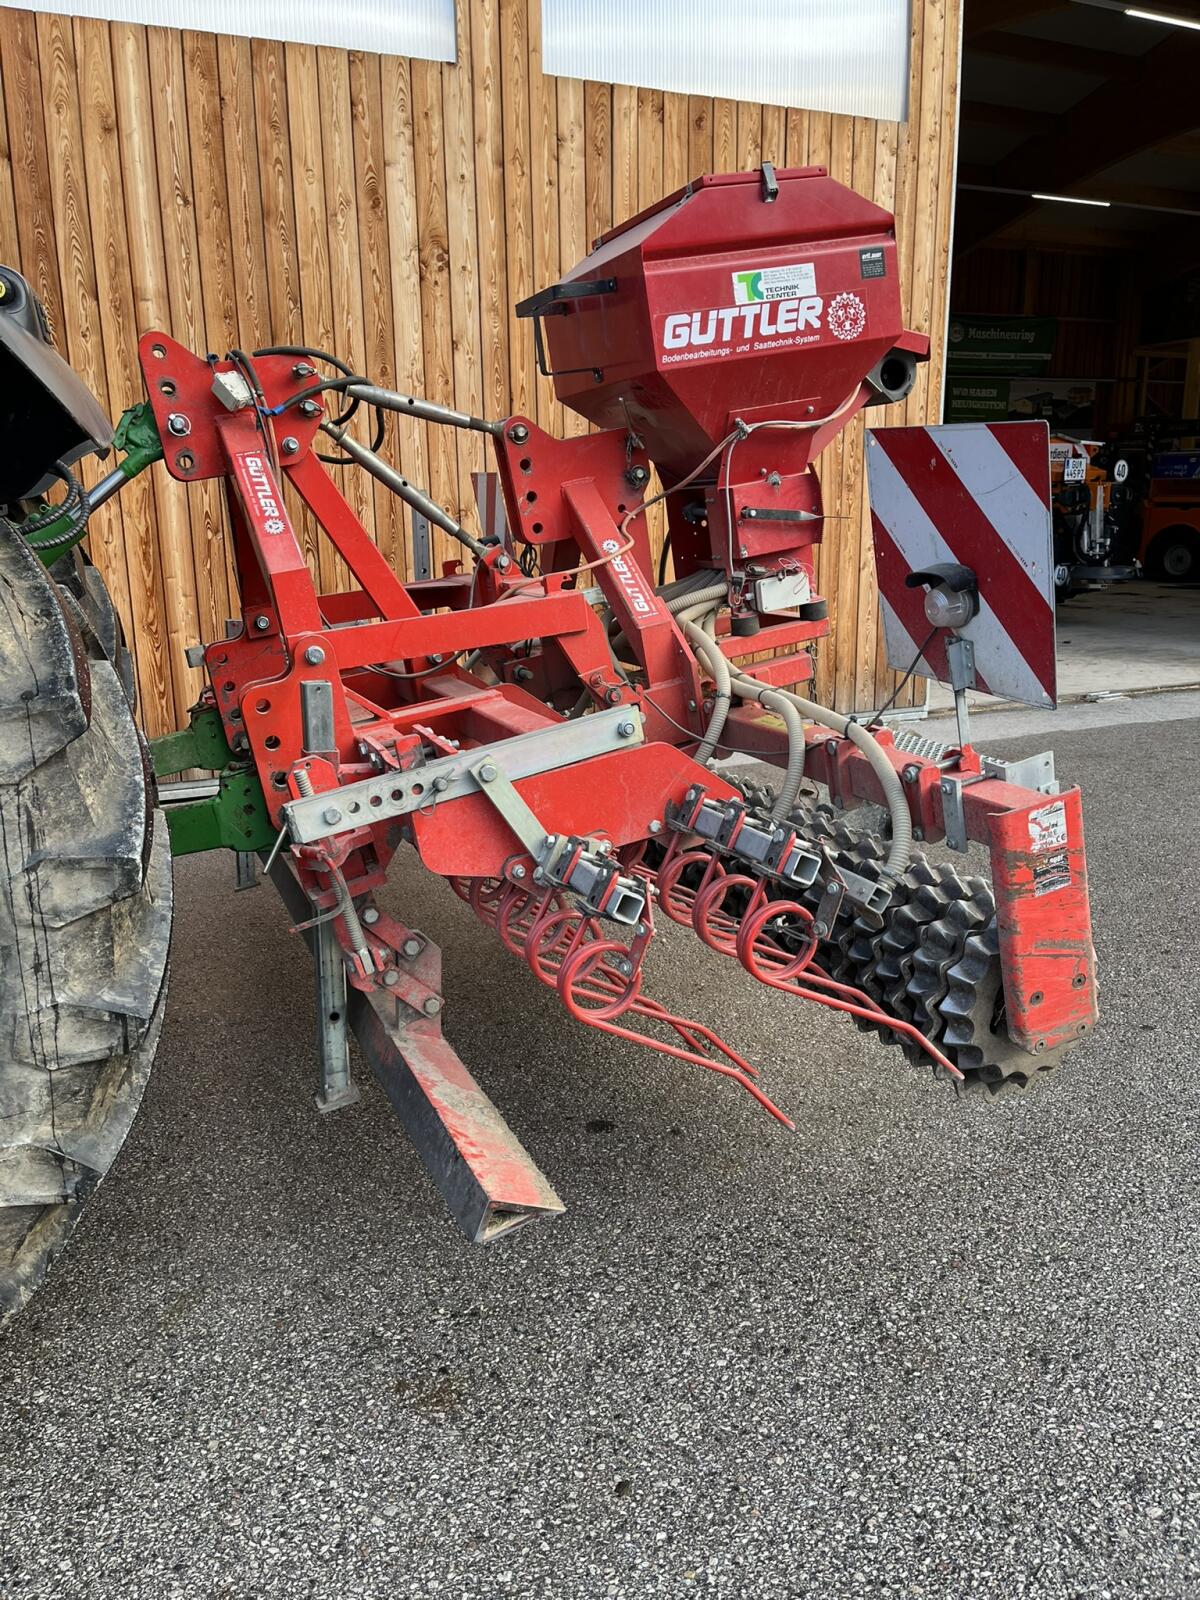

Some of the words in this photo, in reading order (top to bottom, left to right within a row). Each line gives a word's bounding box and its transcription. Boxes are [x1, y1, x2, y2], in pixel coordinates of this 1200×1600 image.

[765, 284, 800, 294] TECHNIK
[765, 291, 797, 301] CENTER
[968, 327, 1036, 343] Maschinenring
[662, 348, 733, 364] Bodenbearbeitungs-
[736, 343, 750, 352] und
[753, 334, 821, 351] Saattechnik-System
[969, 387, 998, 397] HABEN
[1117, 464, 1126, 478] 40
[1056, 567, 1066, 581] 40
